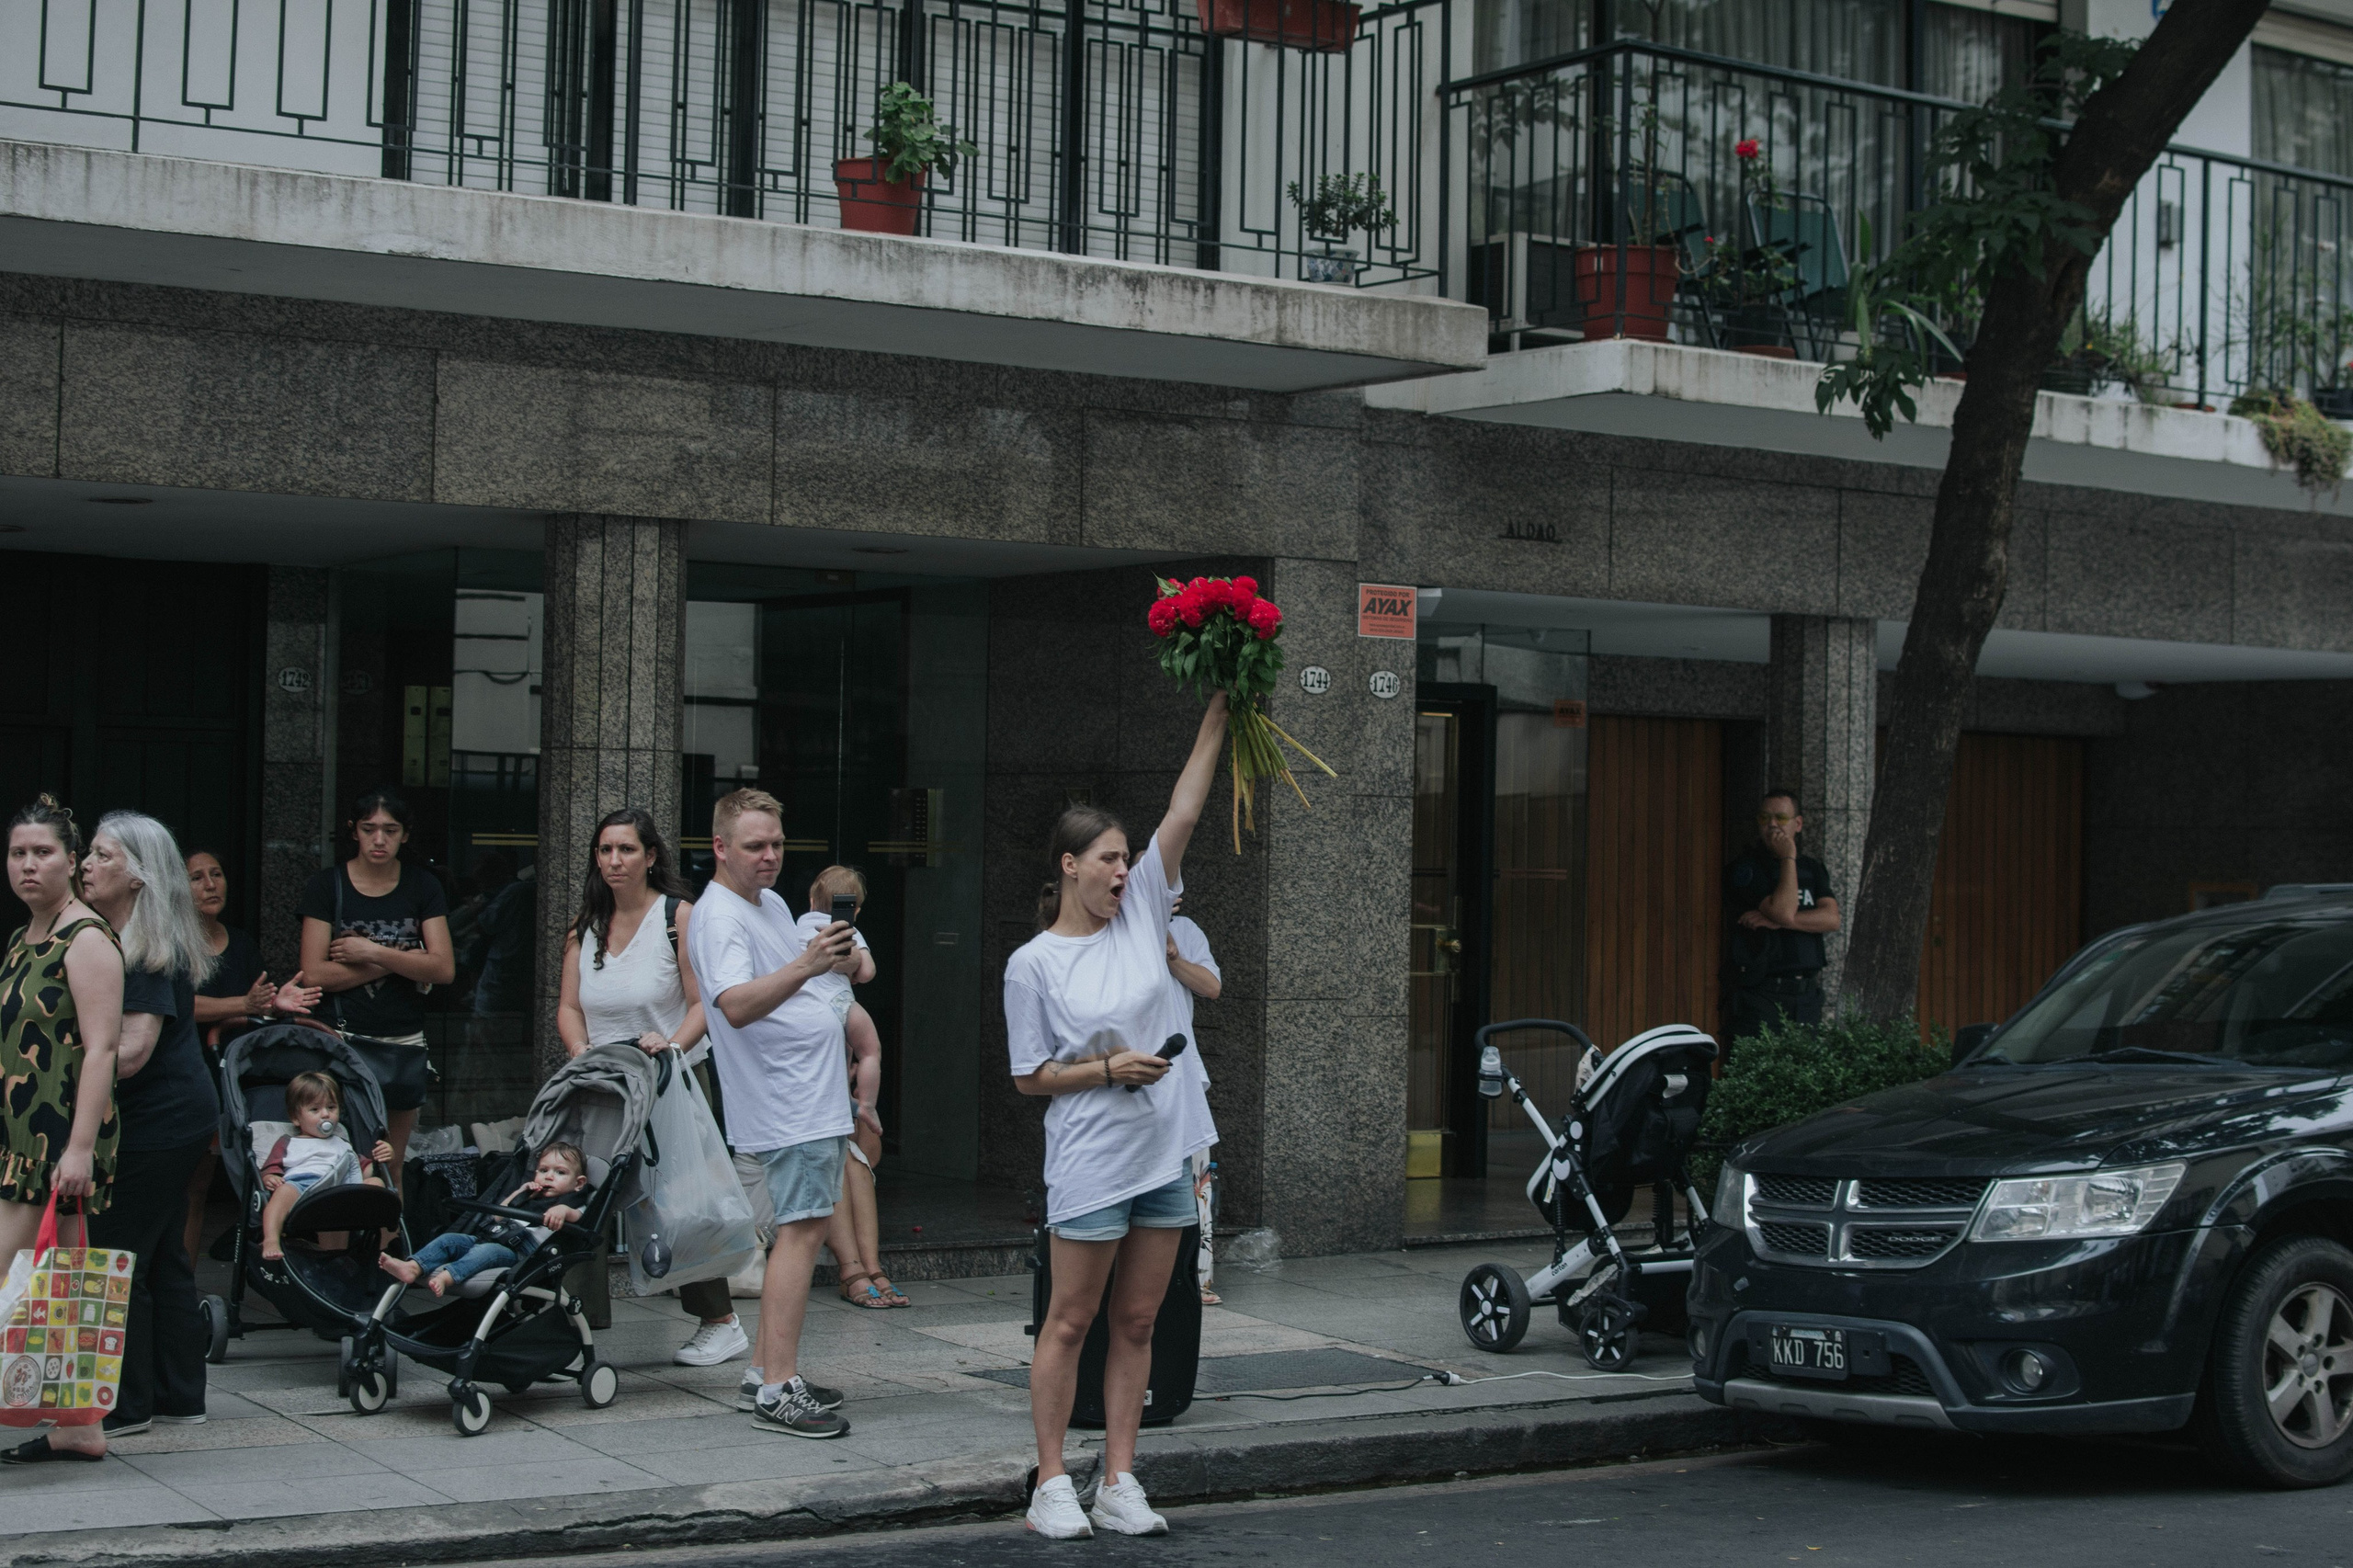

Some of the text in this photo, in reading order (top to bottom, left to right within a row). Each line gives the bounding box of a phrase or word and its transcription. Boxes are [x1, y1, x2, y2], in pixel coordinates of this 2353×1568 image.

[1366, 589, 1397, 597] PROTEGIDO
[1363, 597, 1413, 617] AYAX
[280, 670, 309, 688] 1742
[1302, 670, 1329, 689] 1744
[1372, 676, 1398, 693] 1746
[368, 930, 399, 941] Animal
[1772, 1337, 1845, 1369] KKD 756
